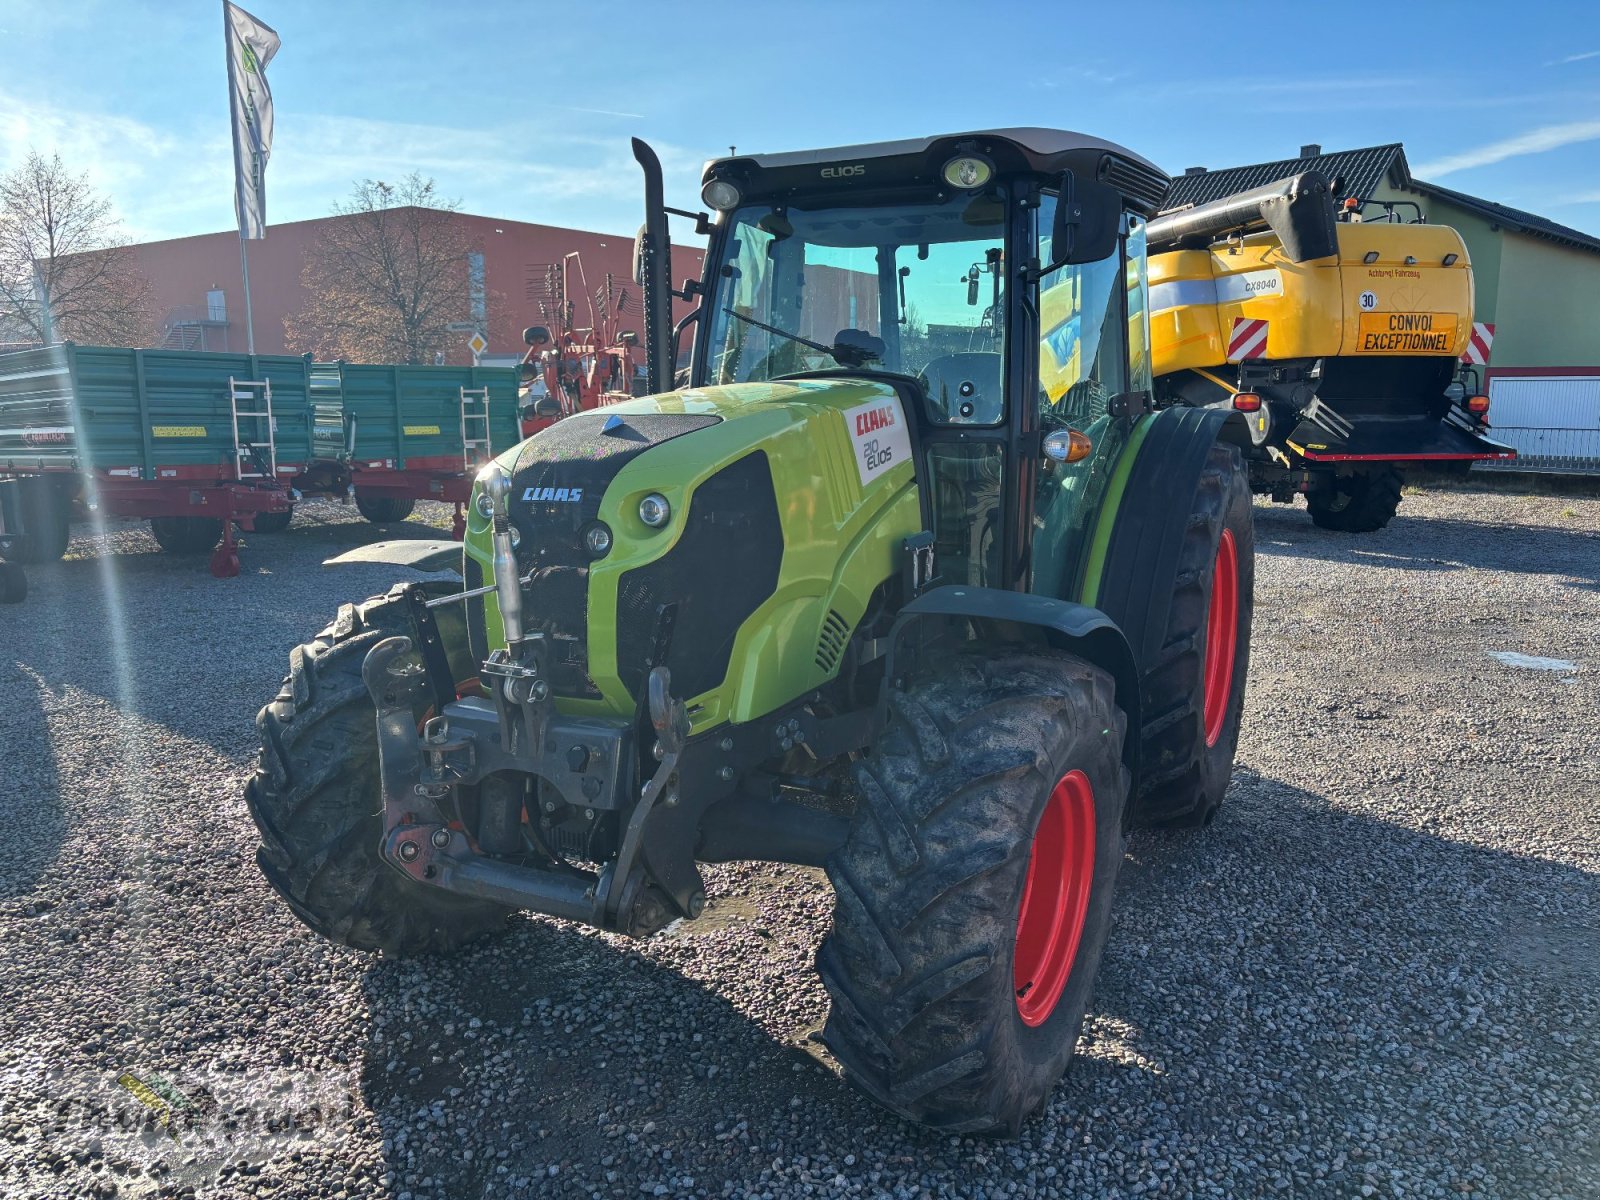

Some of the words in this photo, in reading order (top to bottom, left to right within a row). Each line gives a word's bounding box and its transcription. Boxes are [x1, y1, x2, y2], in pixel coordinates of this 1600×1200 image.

[820, 164, 866, 178] ELIOS
[1245, 278, 1277, 292] CX8040
[1361, 294, 1374, 308] 30
[1389, 314, 1433, 331] CONVOI
[1364, 333, 1447, 350] EXCEPTIONNEL
[856, 406, 895, 436] CLAAS
[864, 439, 879, 458] 210
[867, 447, 892, 471] ELIOS
[522, 487, 583, 502] CLAAS
